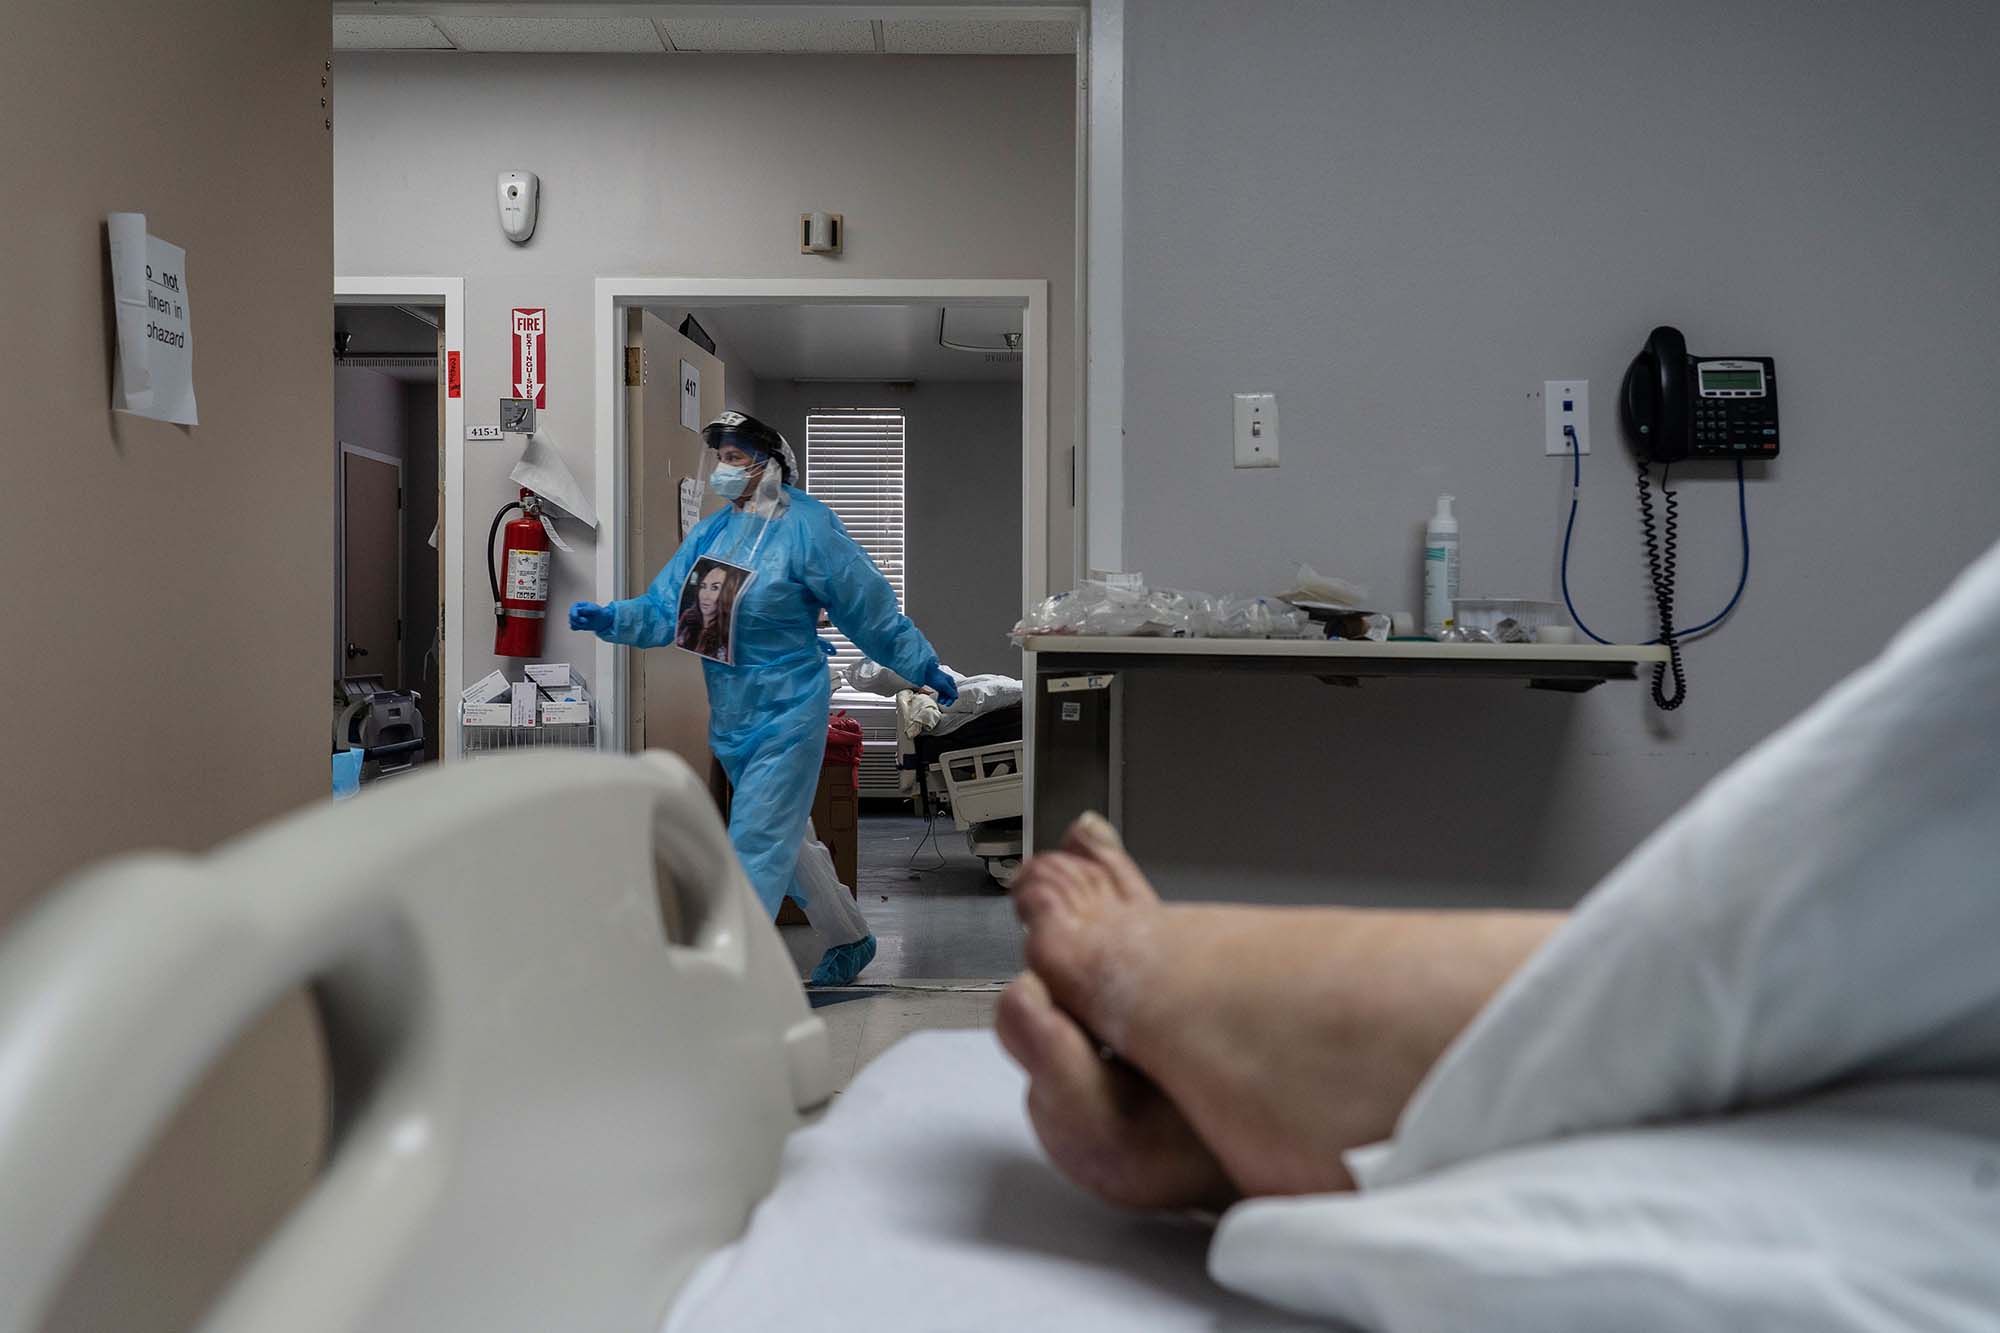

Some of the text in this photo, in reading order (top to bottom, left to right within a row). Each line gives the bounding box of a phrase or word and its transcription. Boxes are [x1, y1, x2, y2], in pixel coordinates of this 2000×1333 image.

[146, 264, 179, 291] o not
[147, 289, 183, 320] linen in
[146, 321, 184, 349] ohazard
[517, 317, 541, 331] FIRE
[684, 377, 697, 398] 417
[471, 427, 499, 436] 415-1
